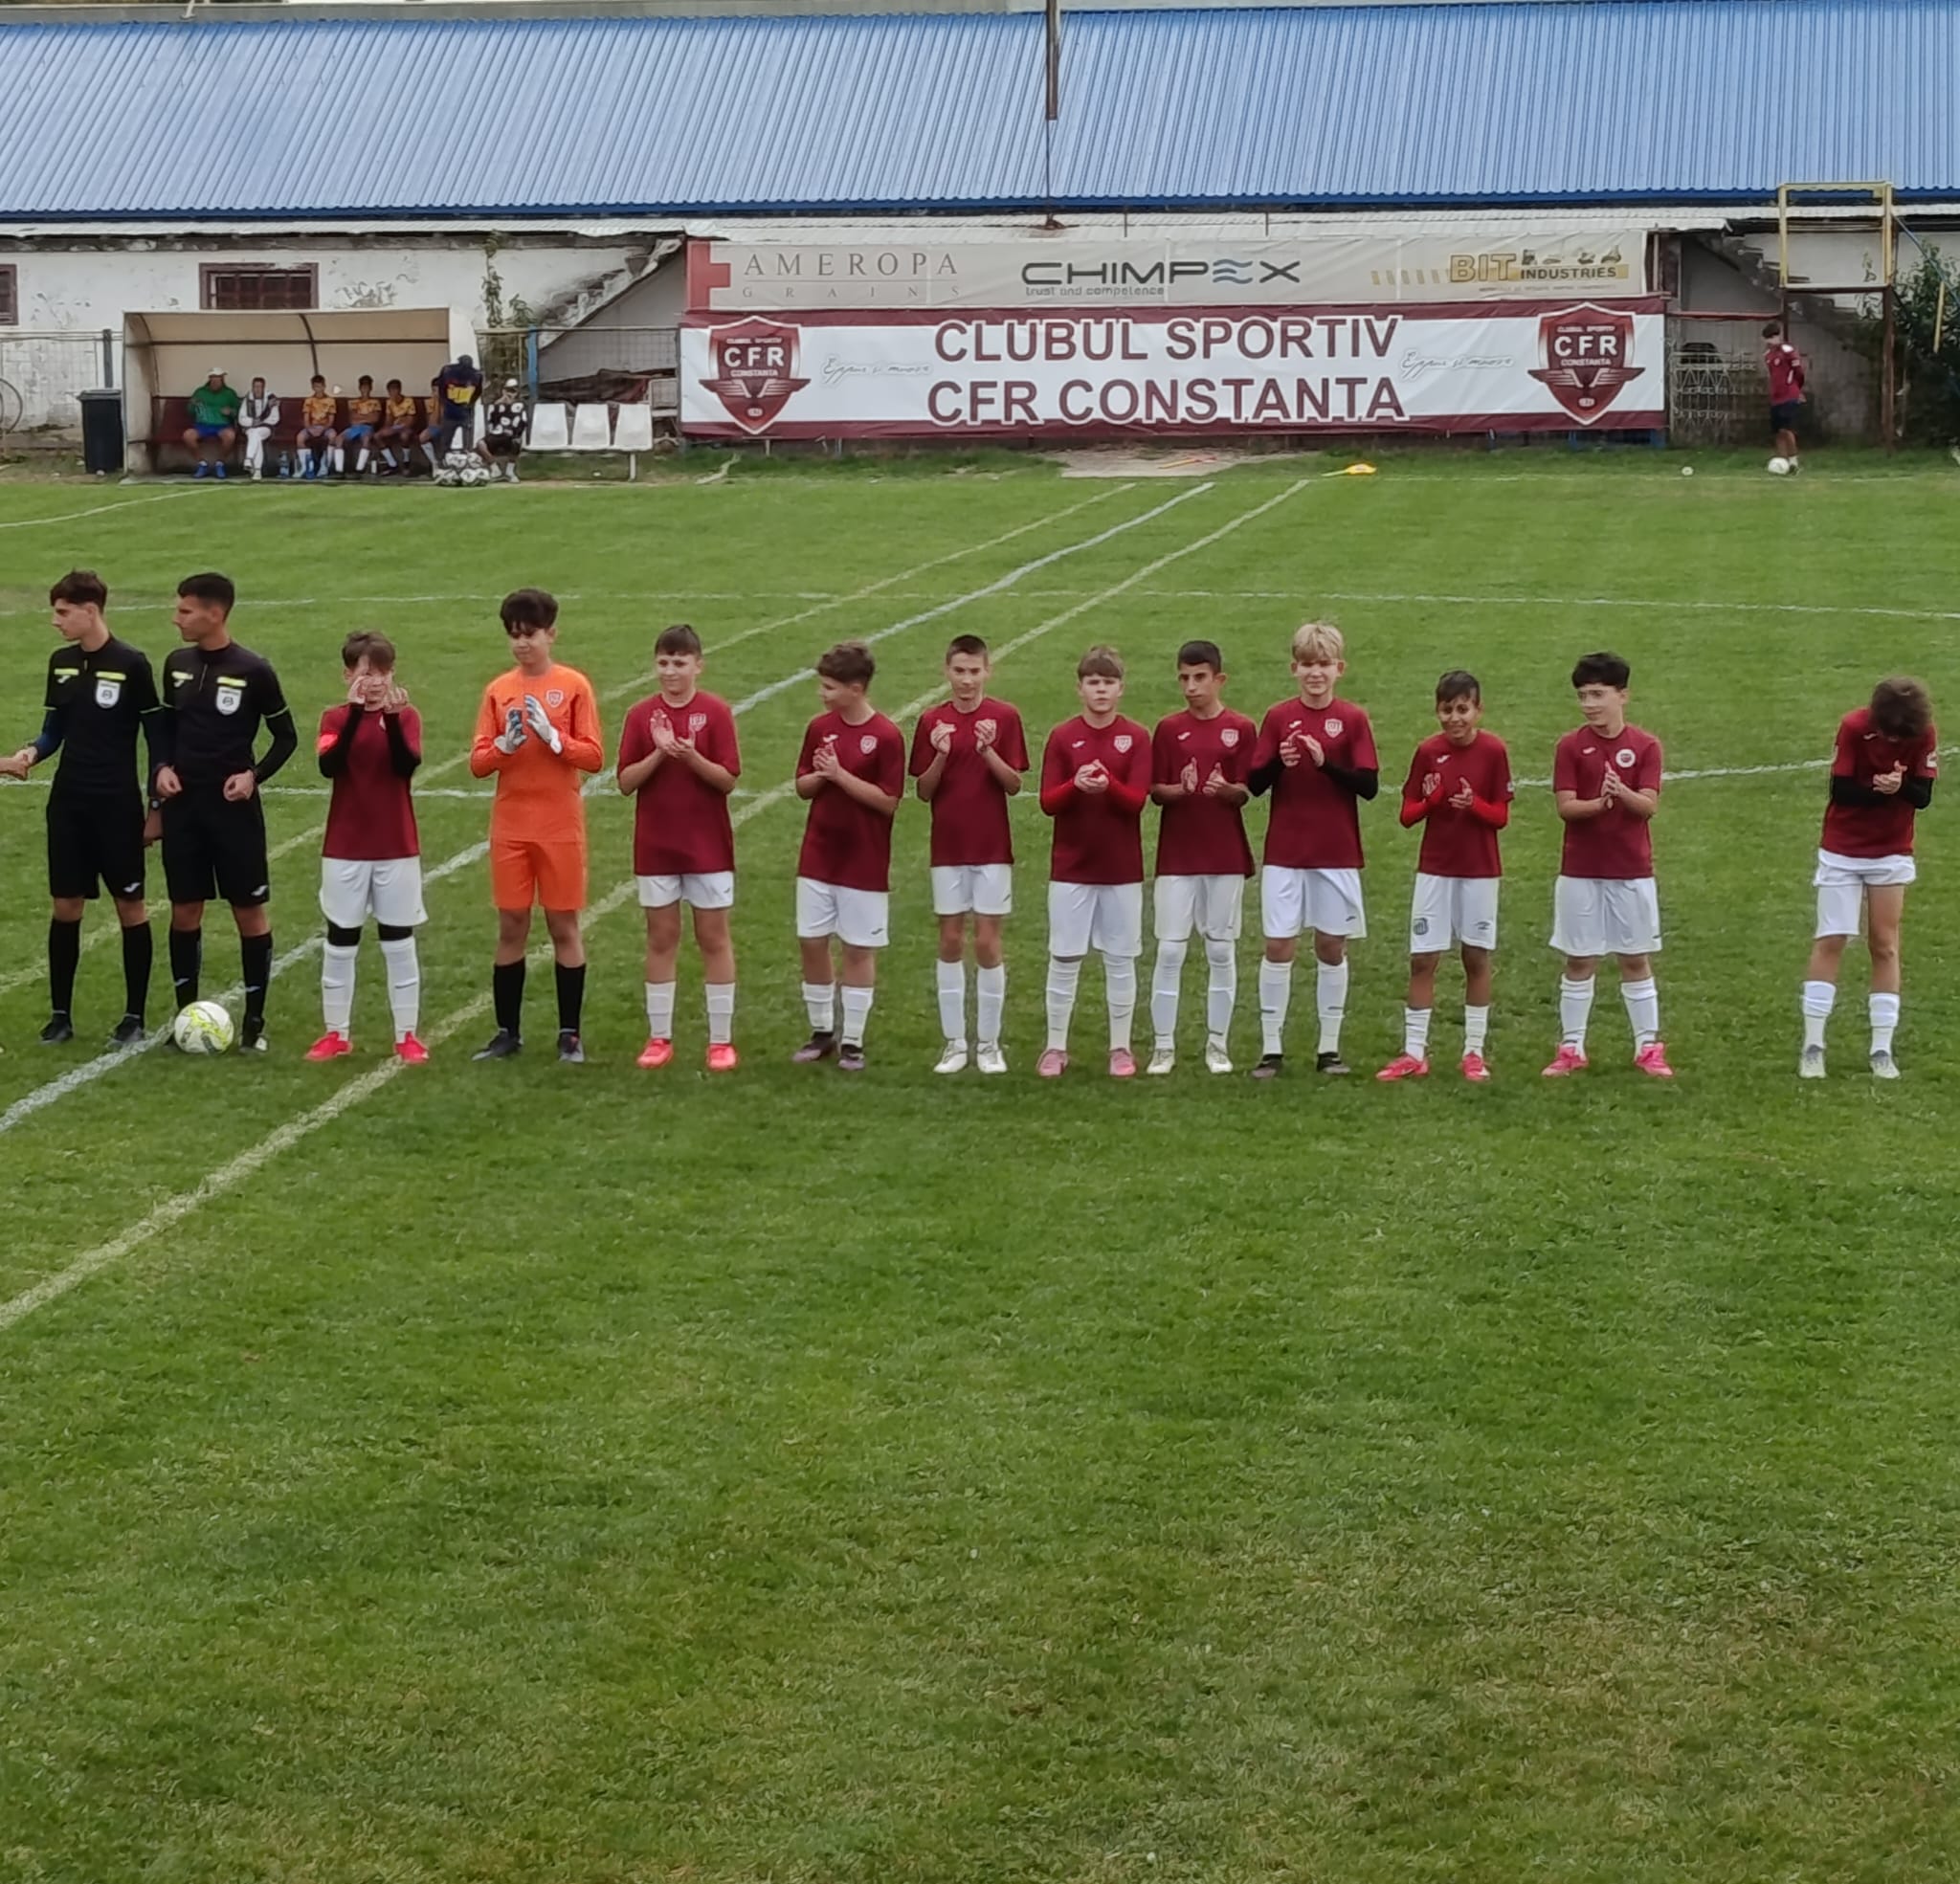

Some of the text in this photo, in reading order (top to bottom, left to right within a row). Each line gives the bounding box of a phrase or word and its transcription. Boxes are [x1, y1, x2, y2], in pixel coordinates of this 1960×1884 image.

[743, 252, 958, 277] AMEROPA
[1021, 258, 1301, 285] CHIMPEX
[1449, 254, 1517, 283] BIT
[1520, 266, 1616, 280] INDUSTRIES
[742, 286, 961, 299] GRAINS
[1025, 286, 1055, 297] trust
[1059, 286, 1082, 297] and
[934, 317, 1398, 363] CLUBUL SPORTIV
[1553, 335, 1618, 357] CFR
[724, 346, 785, 368] CFR
[927, 376, 1407, 424] CFR CONSTANTA
